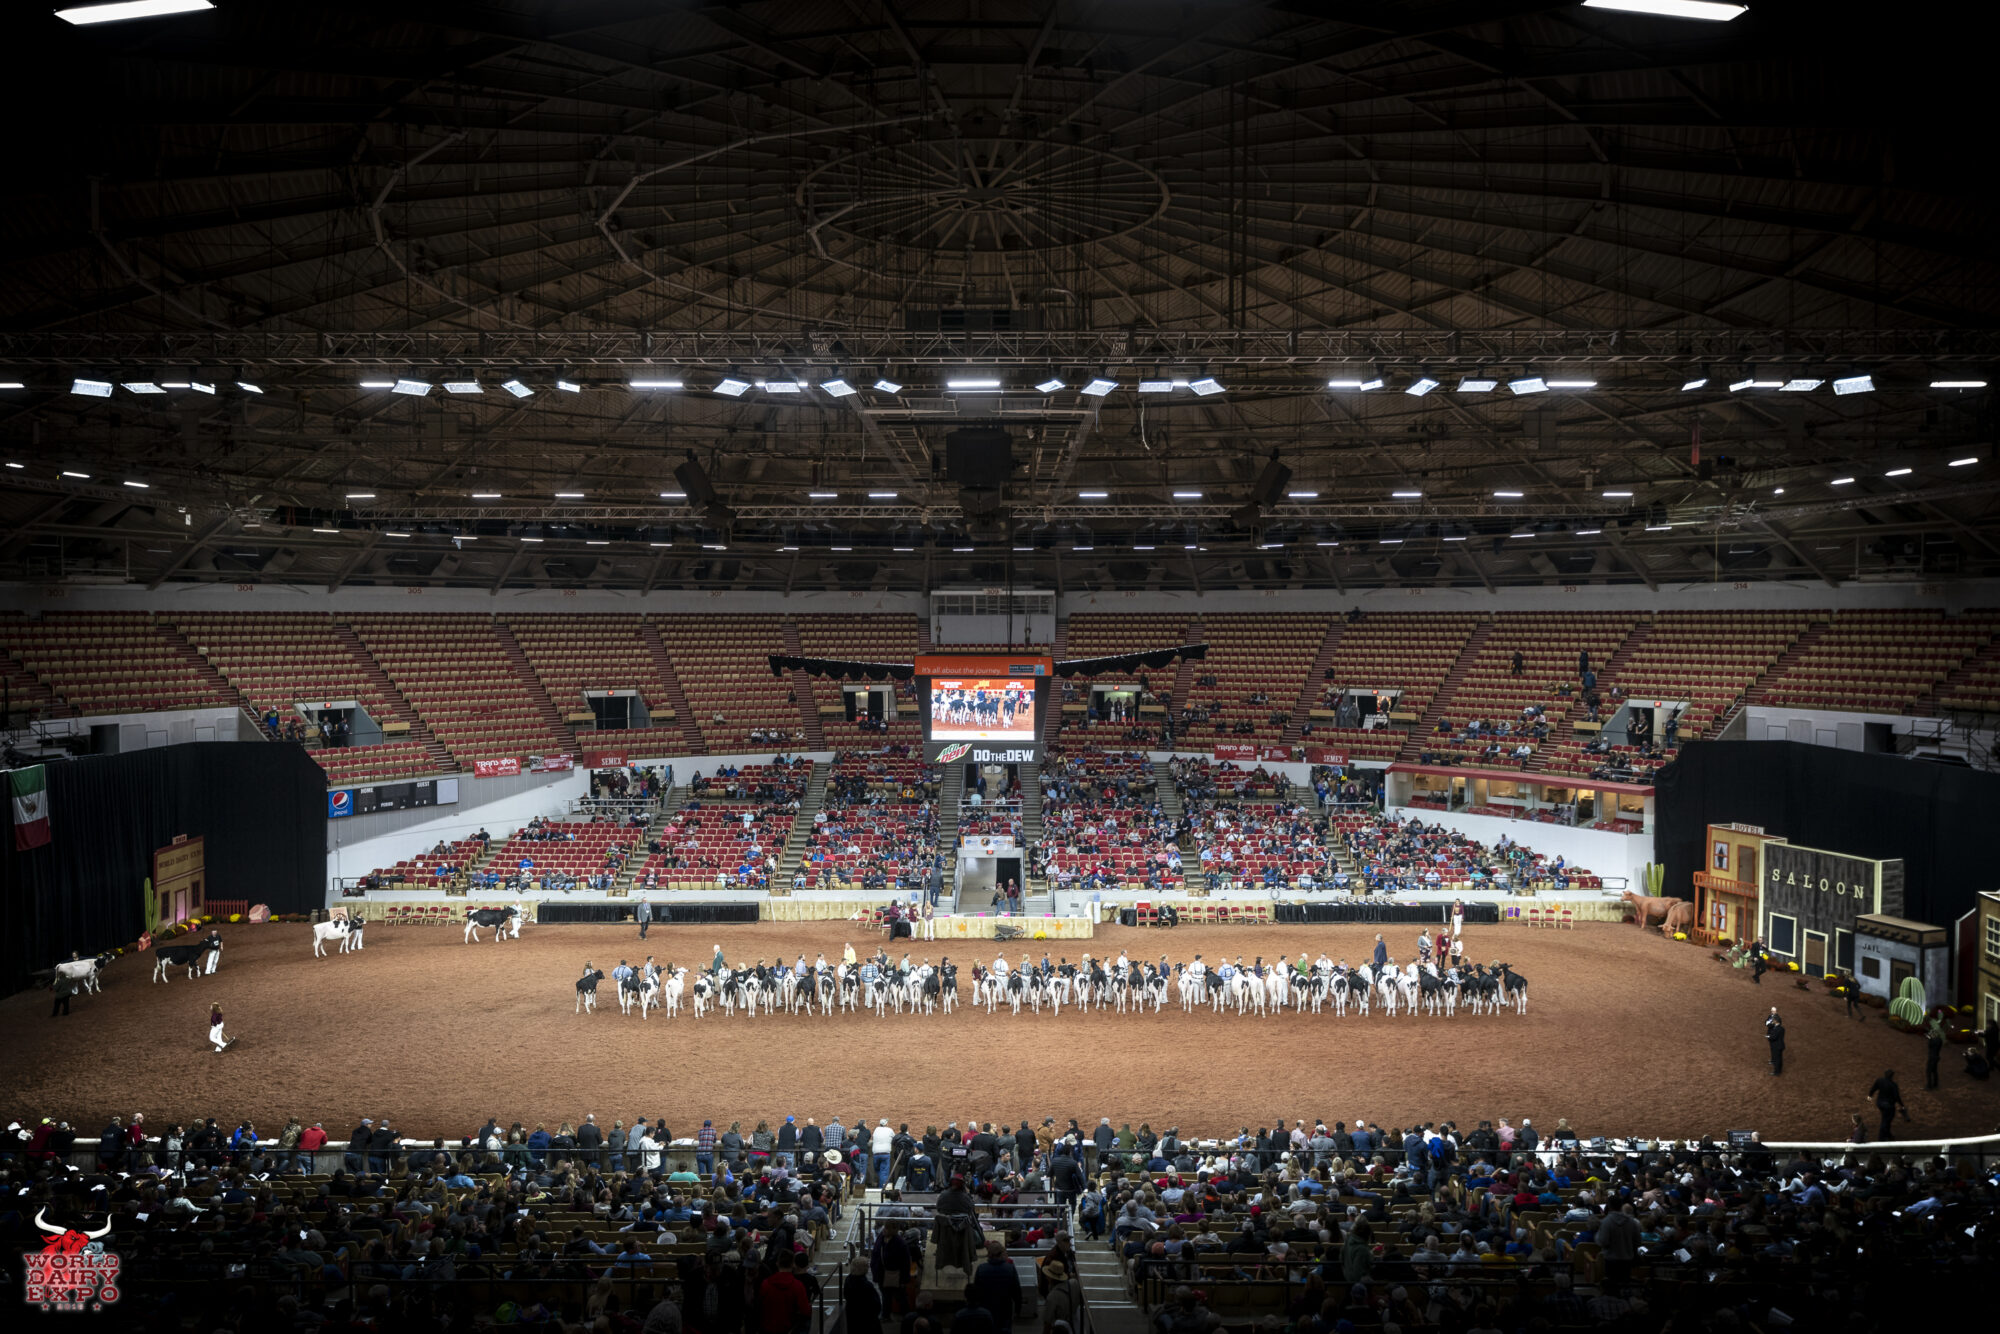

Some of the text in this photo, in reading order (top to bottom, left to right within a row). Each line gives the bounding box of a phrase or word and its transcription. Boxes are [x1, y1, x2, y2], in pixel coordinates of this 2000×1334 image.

[237, 584, 253, 592] 304
[1734, 582, 1748, 590] 314
[973, 749, 1034, 762] DO THE DEW
[1323, 754, 1343, 763] SEMEX
[601, 757, 622, 766] SEMEX
[1734, 823, 1760, 835] HOTEL
[1771, 868, 1864, 899] SALOON
[1862, 943, 1881, 954] JAIL
